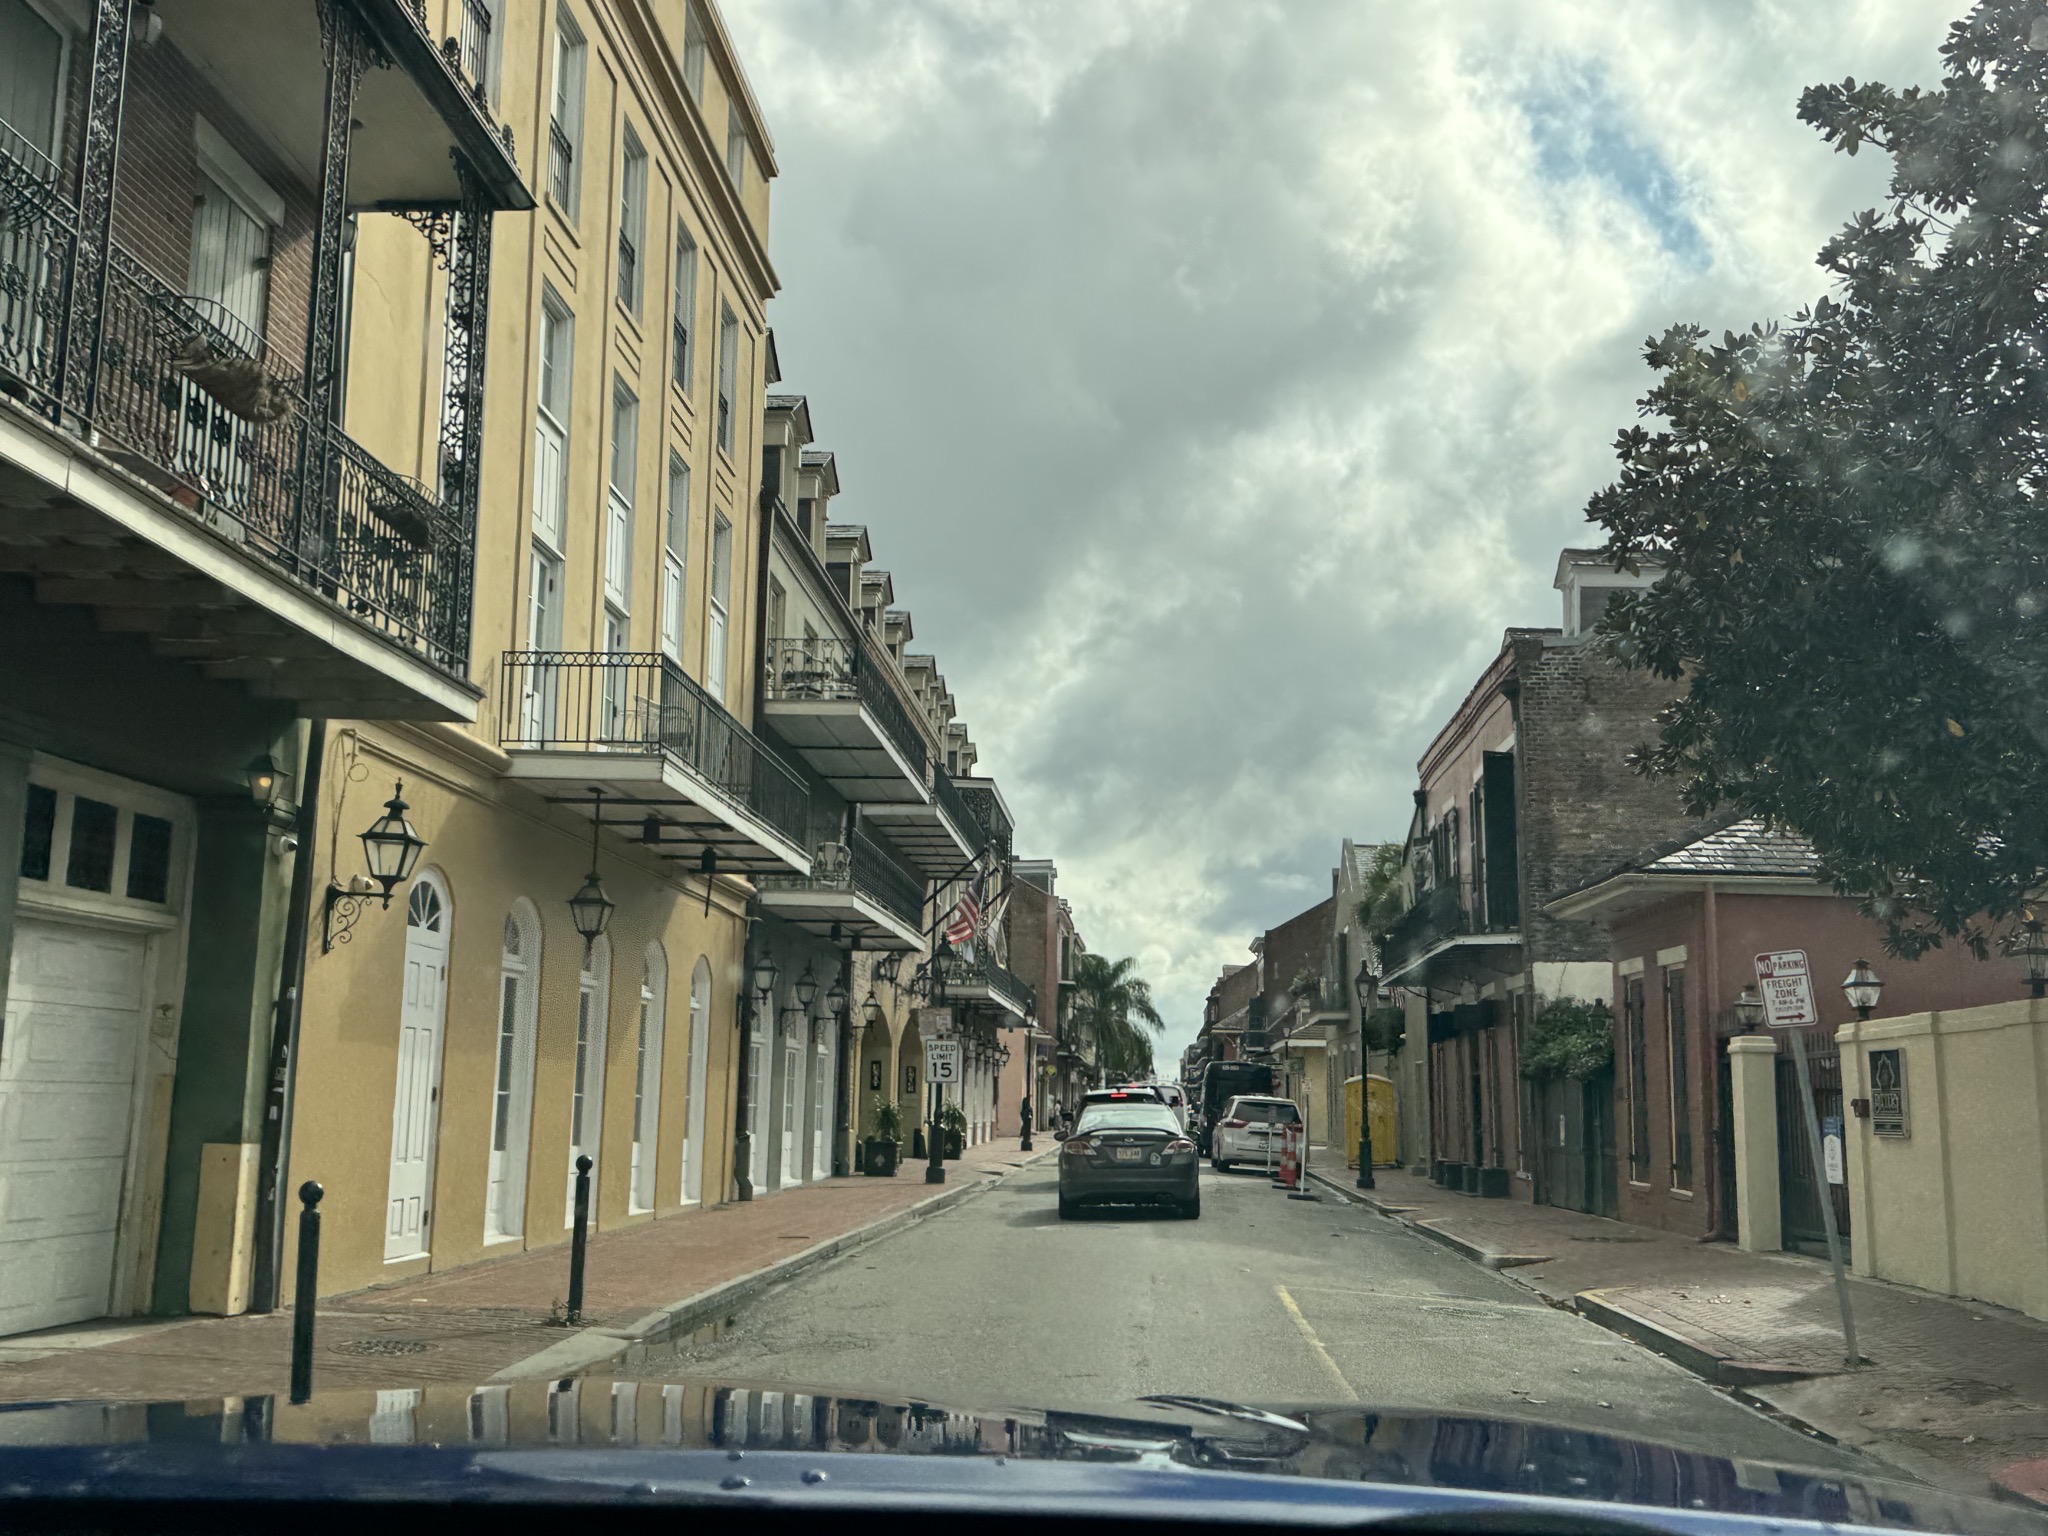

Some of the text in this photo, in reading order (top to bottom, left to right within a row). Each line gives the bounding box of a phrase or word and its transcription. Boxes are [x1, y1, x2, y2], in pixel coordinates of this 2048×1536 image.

[1757, 959, 1805, 974] NO PARKING
[1766, 977, 1803, 990] FREIGHT
[1775, 988, 1798, 999] ZONE
[928, 1044, 956, 1052] SPEED
[932, 1062, 952, 1078] 15
